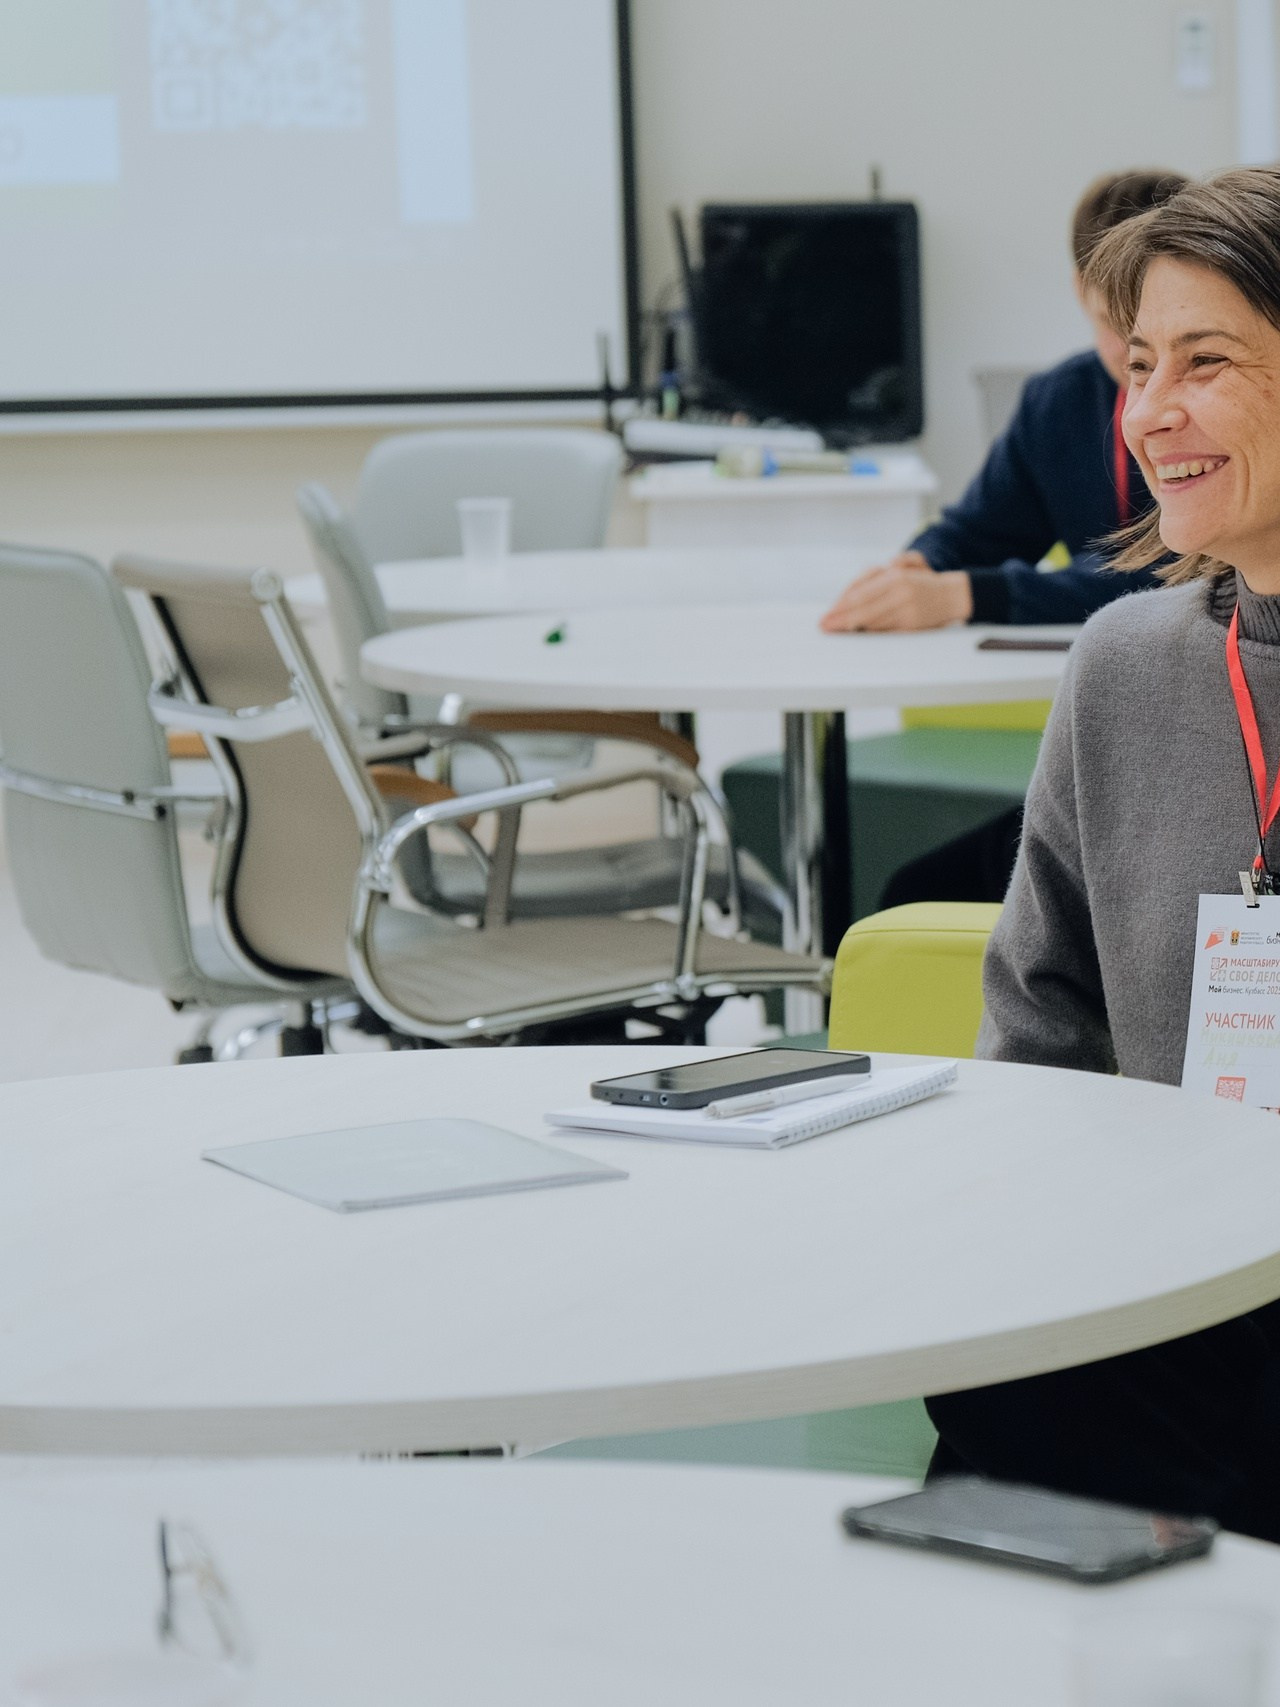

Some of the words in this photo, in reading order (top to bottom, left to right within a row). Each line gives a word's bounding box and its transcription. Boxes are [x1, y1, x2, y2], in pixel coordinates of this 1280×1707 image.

[1229, 970, 1255, 982] СВОЕ
[1208, 985, 1221, 993] Мой
[1205, 1012, 1277, 1030] УЧАСТНИК
